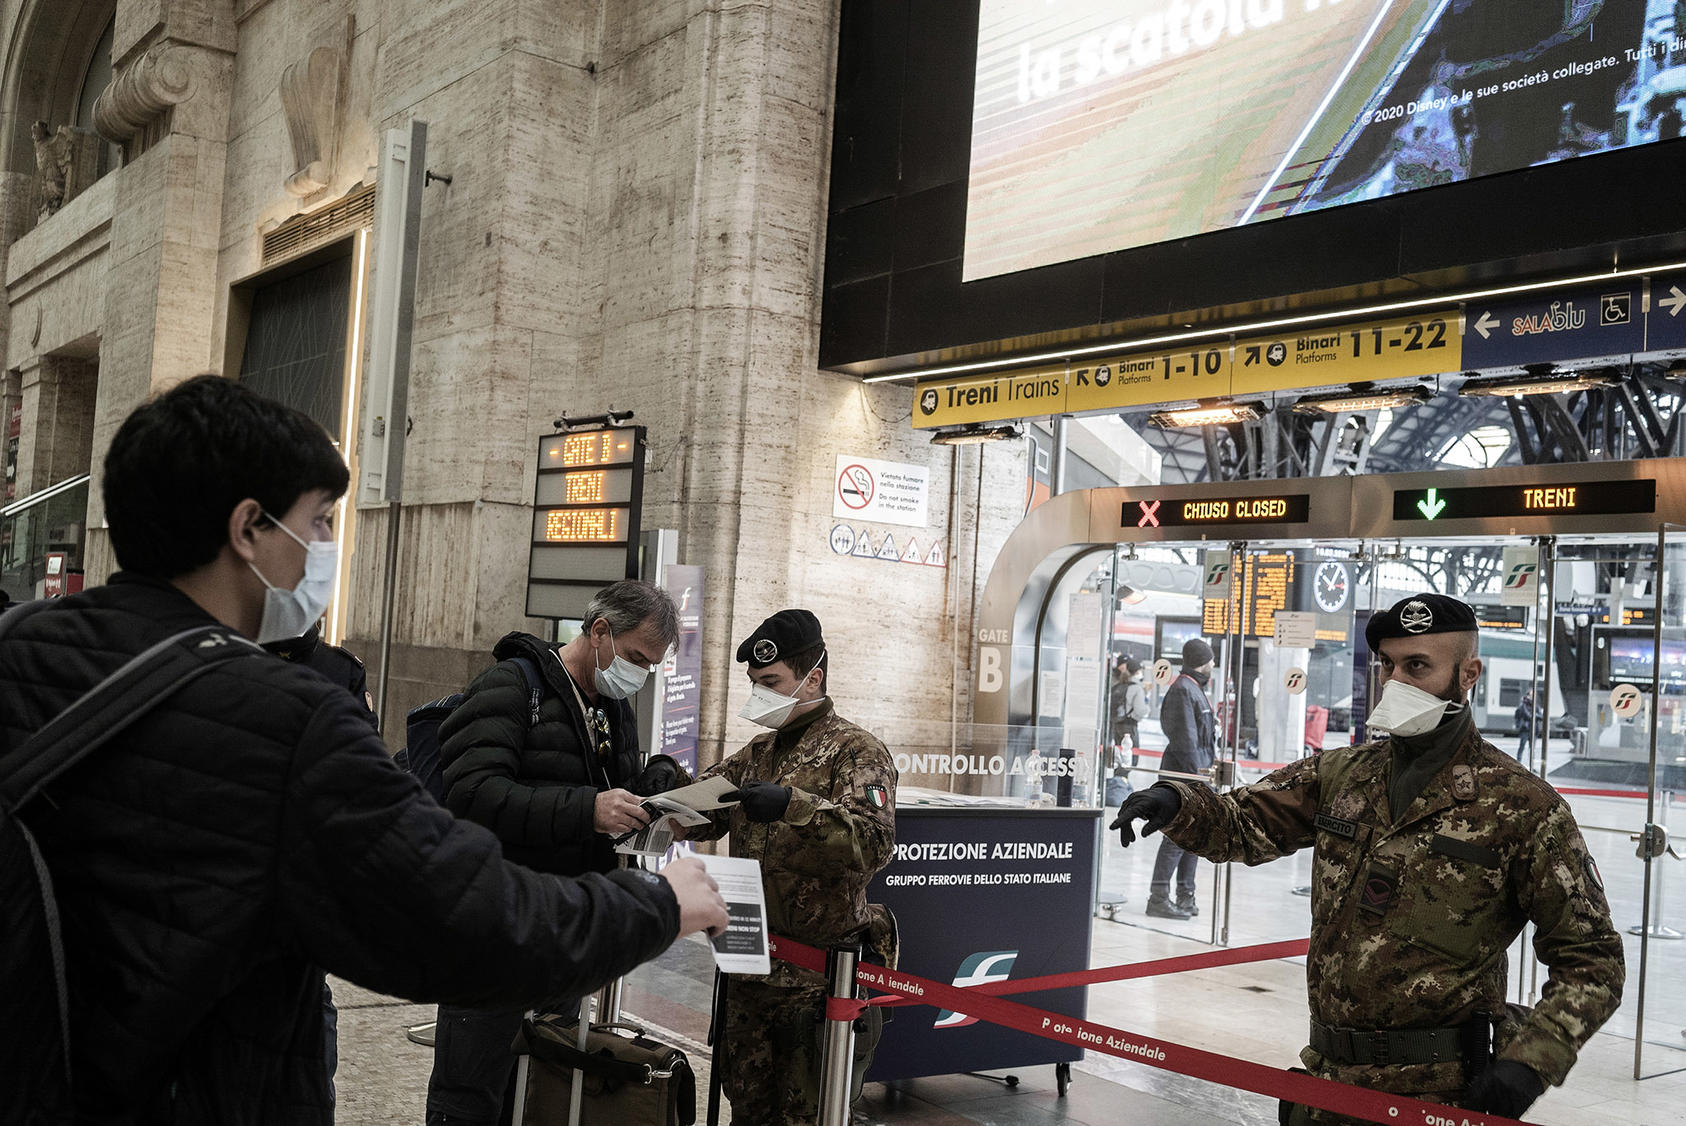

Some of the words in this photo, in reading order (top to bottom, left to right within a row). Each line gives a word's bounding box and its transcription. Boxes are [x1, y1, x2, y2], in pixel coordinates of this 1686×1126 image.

[1016, 42, 1061, 102] la
[1075, 0, 1284, 85] scatola
[1375, 107, 1404, 124] 2020
[1407, 96, 1449, 116] Disney
[1451, 94, 1459, 105] e
[1461, 89, 1473, 102] le
[1477, 83, 1500, 100] sue
[1502, 70, 1549, 92] società
[1552, 55, 1620, 79] collegate.
[1624, 42, 1657, 62] Tutti
[1296, 332, 1341, 352] Binari
[1350, 318, 1447, 358] 11-22
[1118, 357, 1155, 374] Binari
[1162, 348, 1222, 380] 1-10
[1295, 352, 1337, 365] Platforms
[945, 381, 999, 408] Treni
[1005, 375, 1060, 401] Trains
[1118, 373, 1152, 386] Platforms
[565, 473, 604, 502] TRENI
[880, 472, 901, 480] Vietato
[903, 474, 923, 483] fumare
[896, 483, 920, 492] stazione
[1184, 501, 1229, 519] CHIUSO
[1236, 500, 1287, 518] CLOSED
[1523, 487, 1576, 509] TRENI
[546, 510, 617, 540] REGIONALI
[978, 628, 1009, 643] GATE
[978, 646, 1004, 693] B
[893, 752, 1005, 776] ONTROLLO
[1006, 755, 1079, 778] ACCESS
[991, 842, 1073, 860] AZIENDALE
[885, 874, 926, 886] GRUPPO
[928, 874, 972, 886] FERROVIE
[973, 873, 1002, 885] DELLO
[1003, 873, 1032, 884] STATO
[1033, 872, 1072, 884] ITALIANE
[1105, 1035, 1166, 1061] Aziendale
